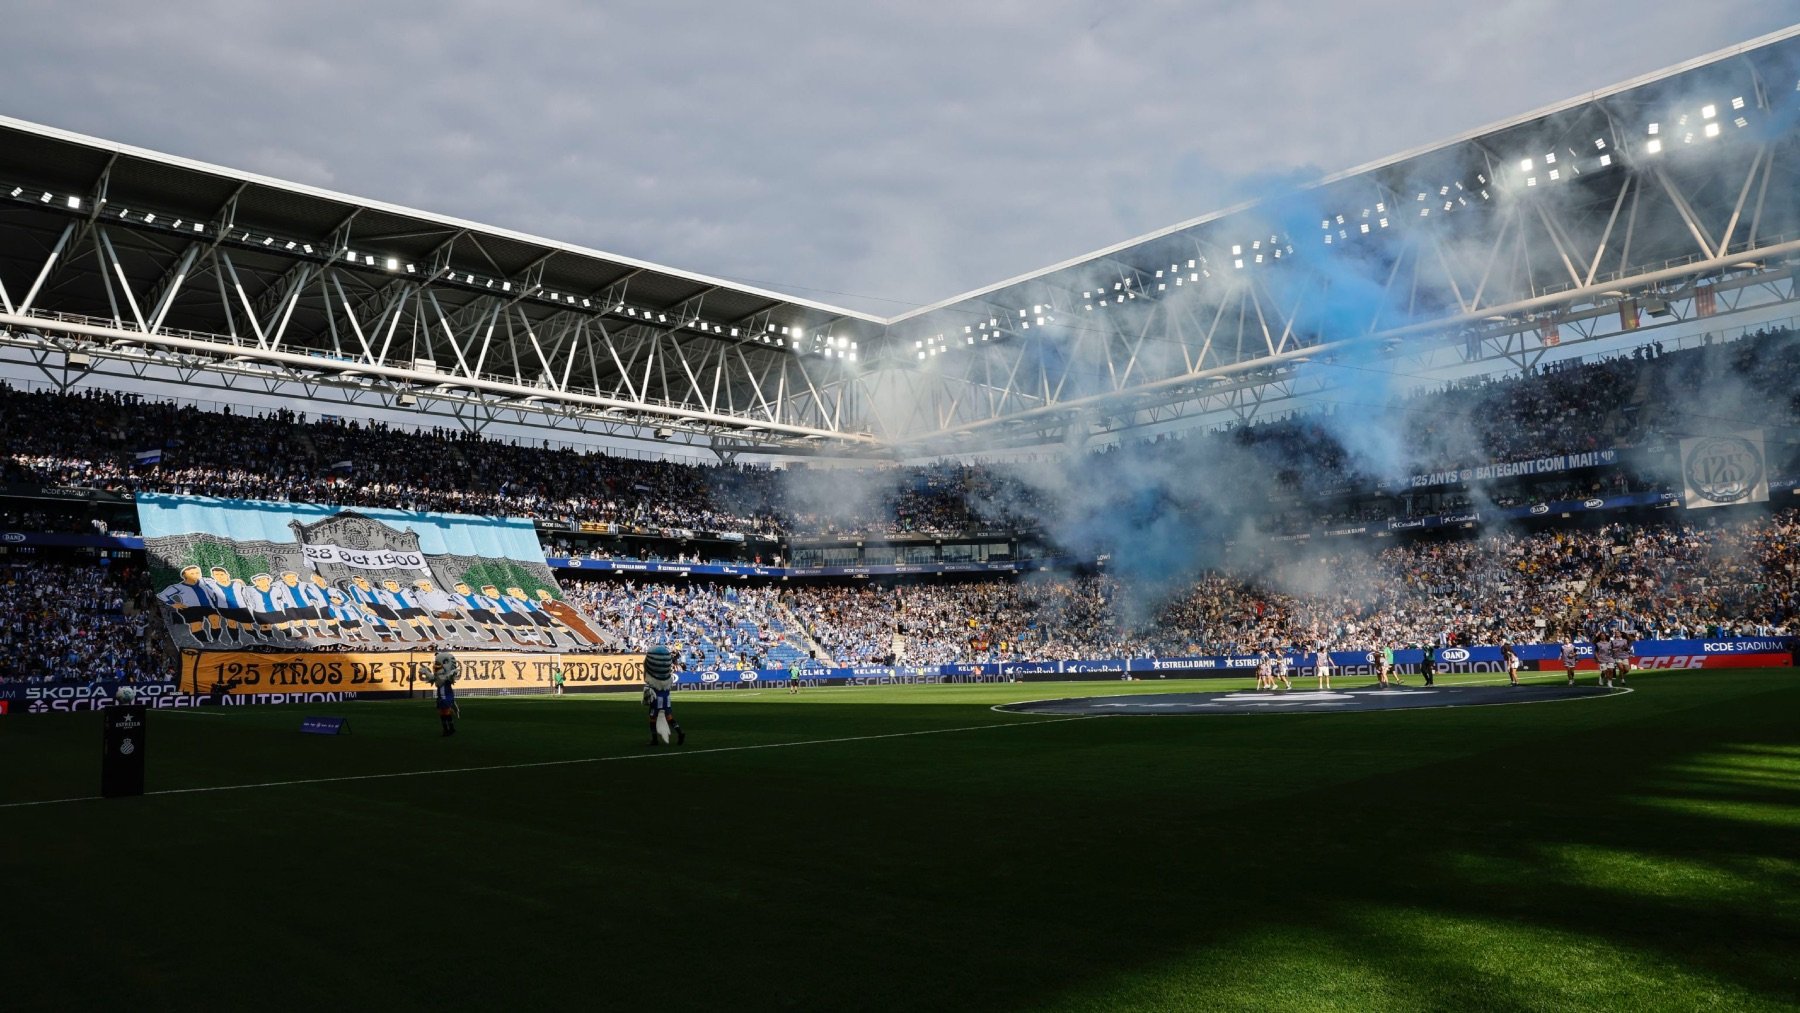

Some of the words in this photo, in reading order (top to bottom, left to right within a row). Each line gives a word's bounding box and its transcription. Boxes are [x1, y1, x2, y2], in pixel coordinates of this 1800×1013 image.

[1411, 474, 1429, 488] 125
[1428, 470, 1458, 486] ANYS
[1476, 460, 1535, 480] BATEGANT
[1536, 455, 1565, 473] COM
[305, 547, 332, 560] 28
[1704, 642, 1734, 652] RCDE
[1736, 641, 1783, 651] STADIUM
[1162, 661, 1194, 669] ESTRELLA
[1194, 660, 1216, 668] DAMM
[214, 662, 261, 685] 125
[269, 658, 342, 685] AÑOS
[350, 662, 384, 684] DE
[511, 661, 527, 681] Y
[854, 667, 882, 675] KELME
